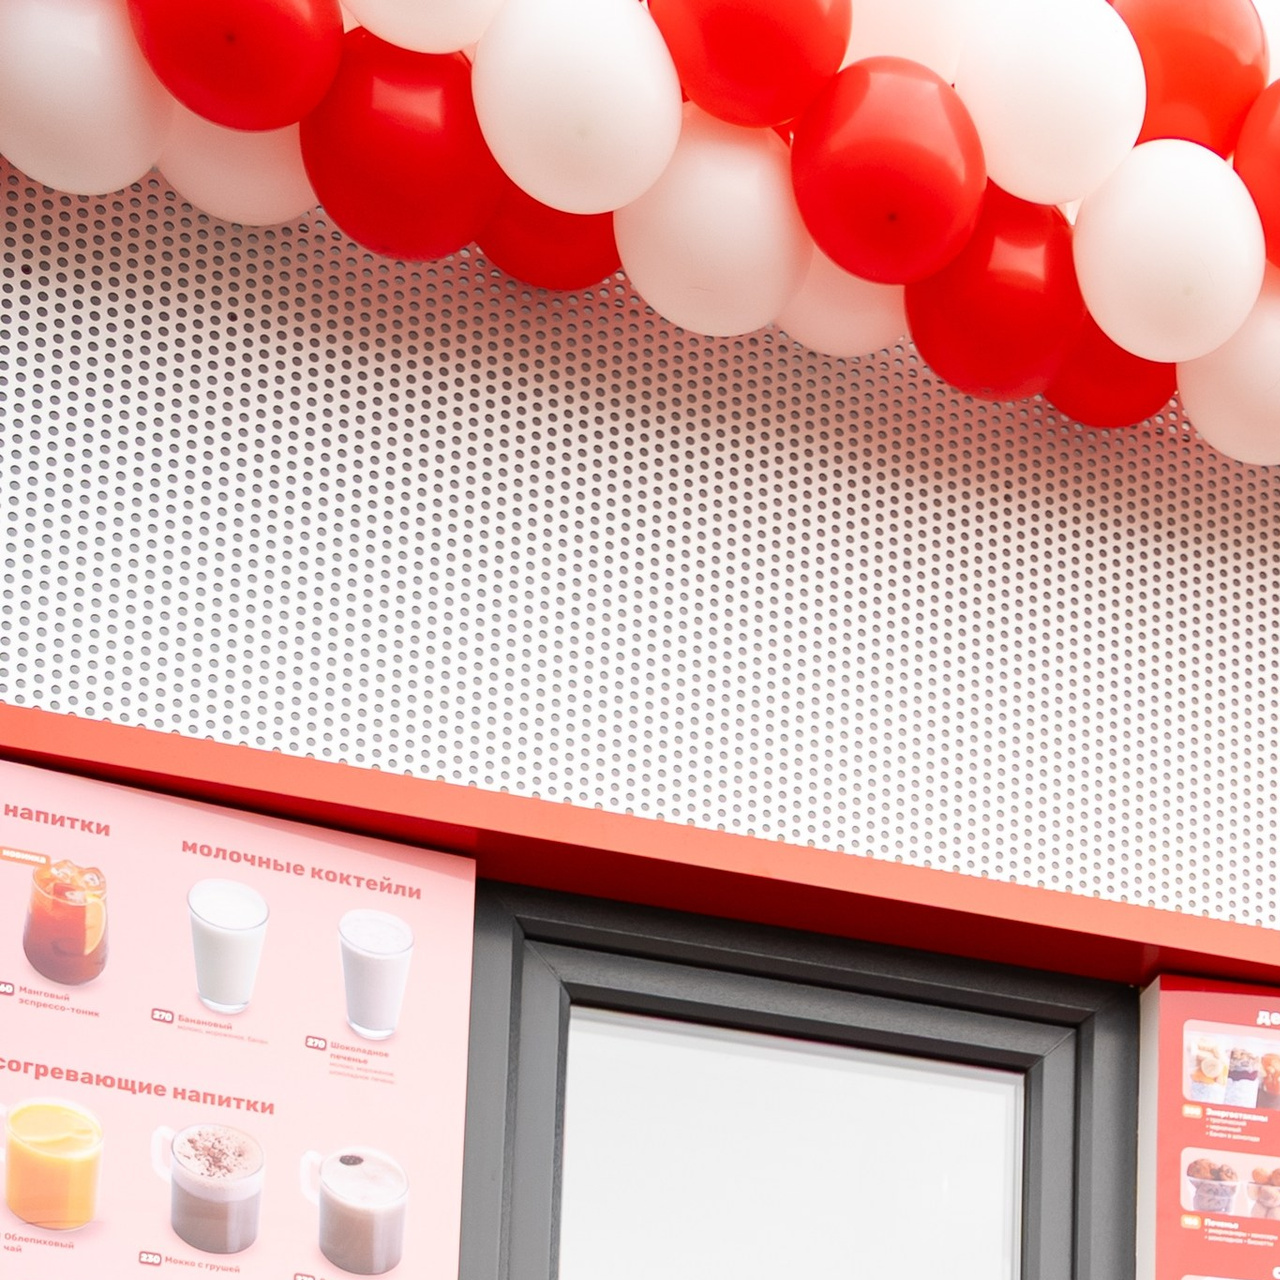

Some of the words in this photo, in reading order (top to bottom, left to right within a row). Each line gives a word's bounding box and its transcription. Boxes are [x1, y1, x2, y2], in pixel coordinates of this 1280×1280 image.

[3, 803, 111, 837] напитки
[181, 840, 306, 876] молочные
[310, 866, 422, 900] коктейли
[19, 986, 70, 1002] Манговый
[18, 998, 100, 1017] эспрессо-тоник
[177, 1014, 233, 1031] Банановый
[307, 1038, 325, 1049] 270
[330, 1041, 389, 1058] Шоколадное
[172, 1085, 275, 1115] напитки
[4, 1232, 75, 1250] Облепиховый
[4, 1244, 22, 1254] чай
[165, 1256, 196, 1267] Мокко
[205, 1261, 241, 1275] грушей
